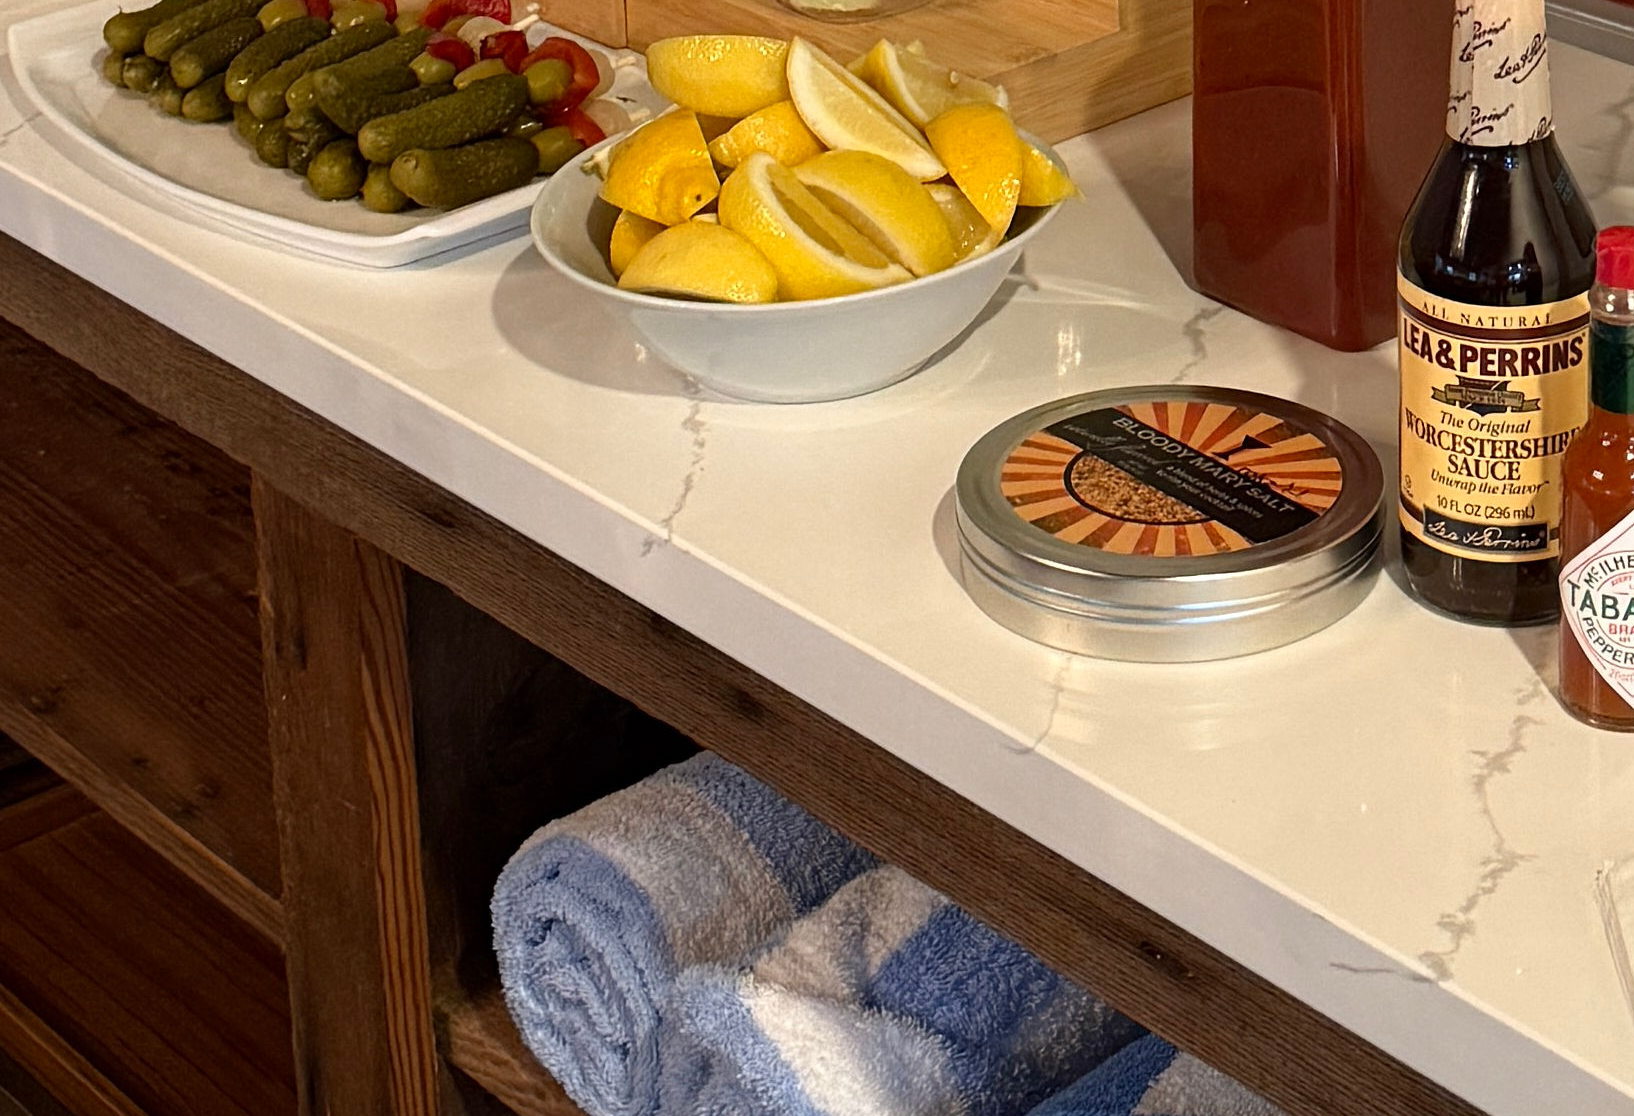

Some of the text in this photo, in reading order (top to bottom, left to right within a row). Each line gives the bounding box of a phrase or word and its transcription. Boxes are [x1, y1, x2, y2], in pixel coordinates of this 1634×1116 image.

[1422, 301, 1554, 329] ALL NATURAL
[1440, 410, 1532, 437] The Original
[1112, 416, 1191, 459] BLOODY
[1188, 456, 1248, 488] MARY
[1246, 487, 1297, 513] SALT
[1447, 454, 1522, 481] SAUCE
[1430, 468, 1477, 494] Unwrap
[1478, 481, 1500, 495] the
[1436, 494, 1448, 509] 10
[1449, 499, 1462, 513] FL
[1464, 503, 1481, 517] OZ
[1484, 505, 1511, 520] (296
[1582, 616, 1634, 665] PEPPER
